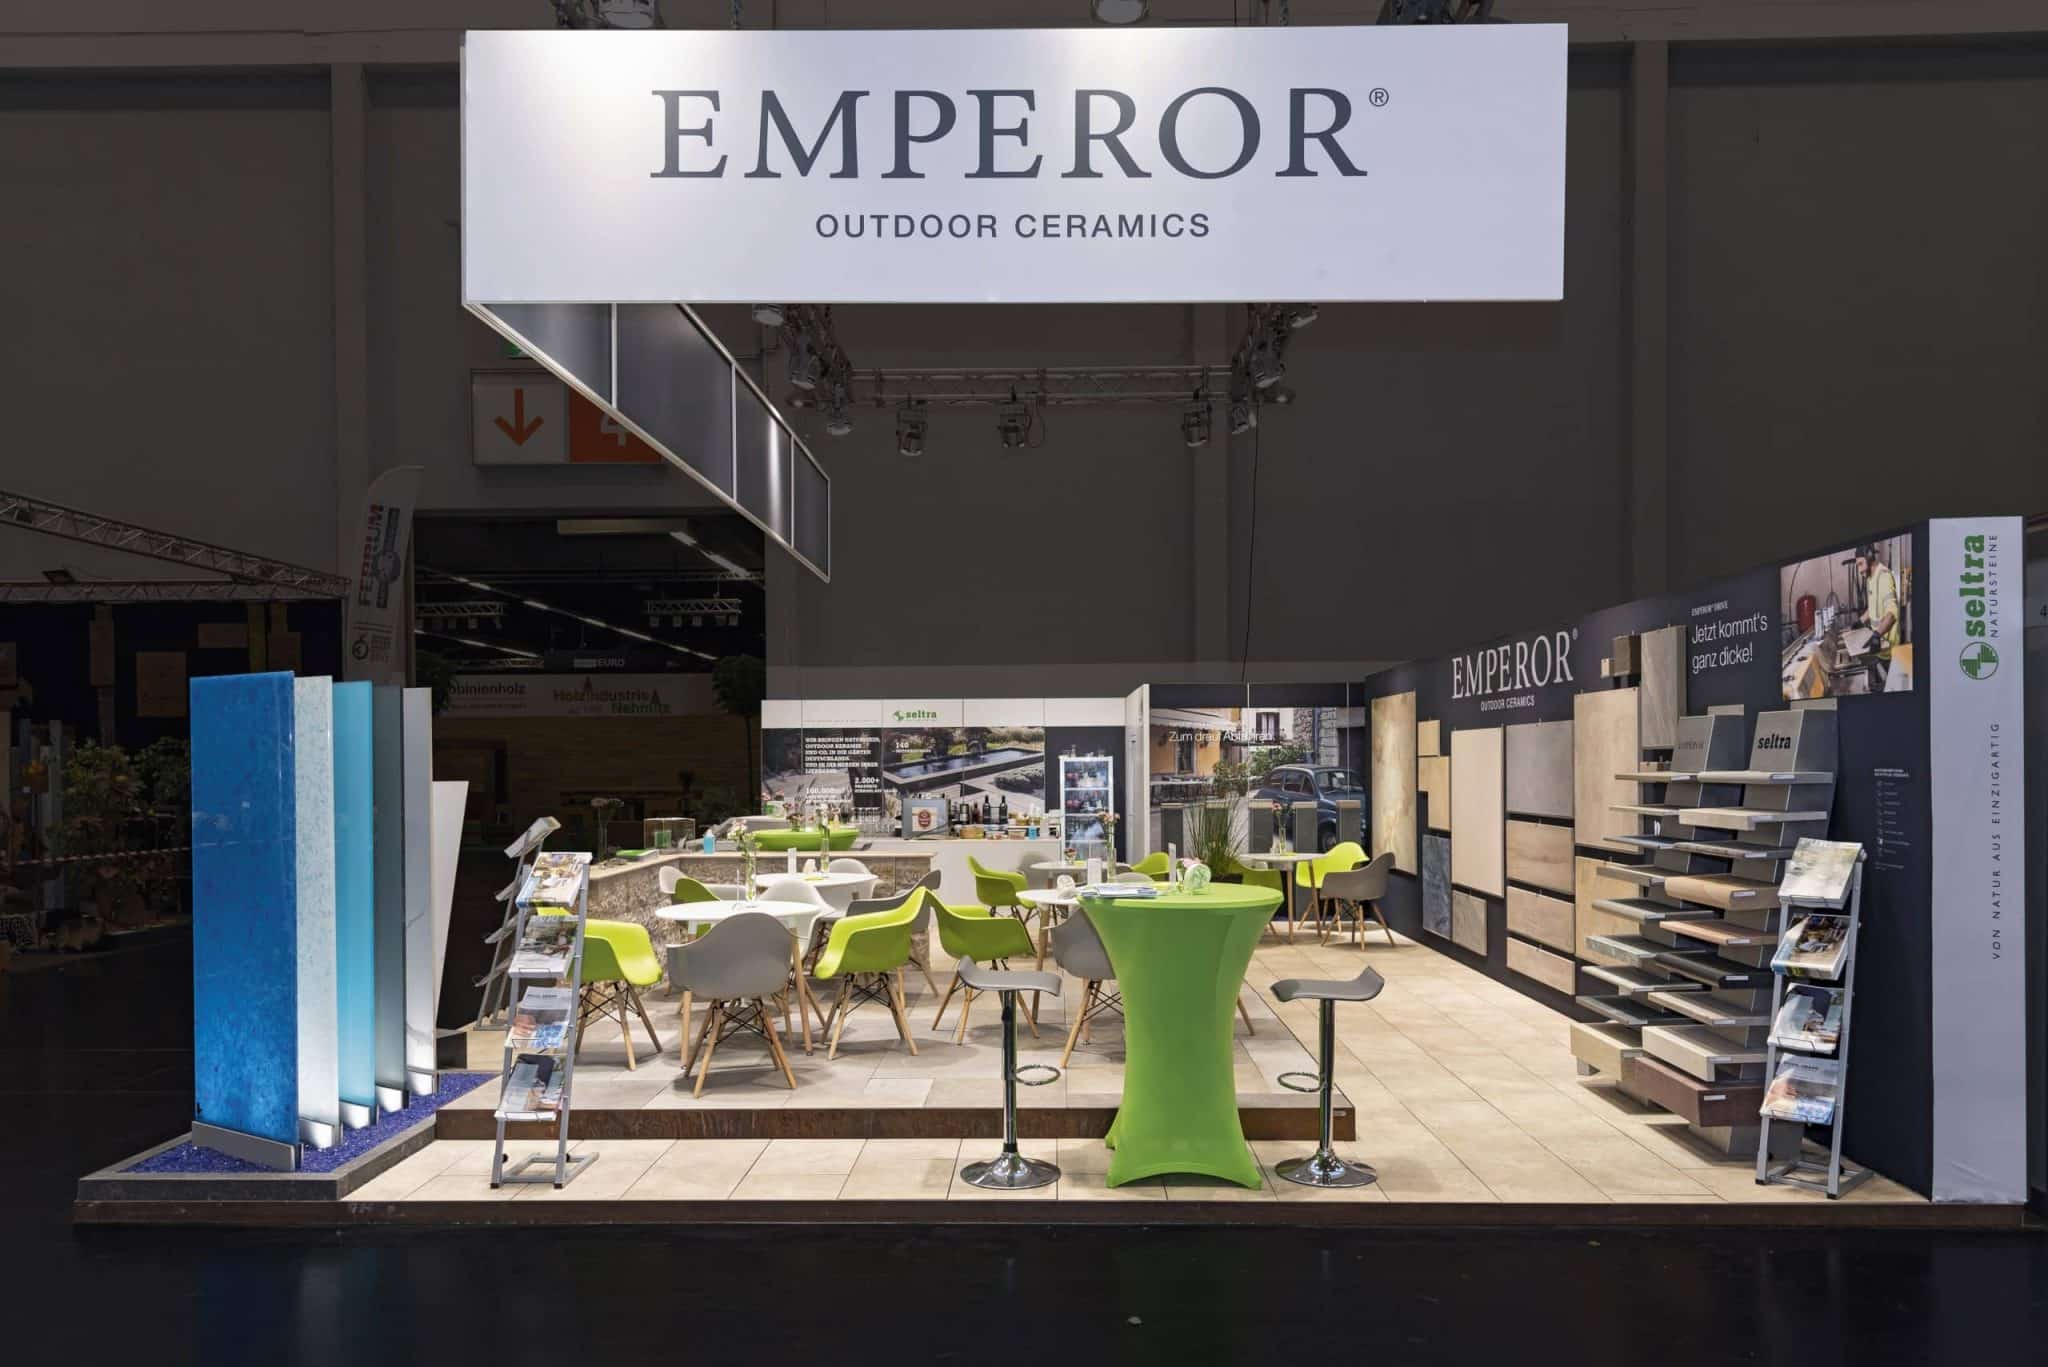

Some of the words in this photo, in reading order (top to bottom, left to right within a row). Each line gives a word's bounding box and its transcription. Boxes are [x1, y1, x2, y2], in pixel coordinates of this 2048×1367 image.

[816, 213, 998, 239] OUTDOOR
[1015, 212, 1210, 239] CERAMICS
[1959, 534, 1986, 638] seltra
[1989, 534, 2000, 638] NATURSTEINE
[1692, 622, 1717, 644] Jetzt
[1692, 652, 1718, 675] ganz
[1719, 641, 1753, 666] dicke!
[449, 682, 527, 696] obinienholz
[1480, 699, 1505, 712] OUTDOOR
[1506, 695, 1536, 709] CERAMICS
[1168, 730, 1193, 742] Zum
[1757, 733, 1792, 750] seltra
[1990, 723, 2001, 825] EINZIGARTIG
[1991, 834, 2001, 862] AUS
[1991, 869, 2001, 920] NATUR
[1991, 928, 2001, 961] VON
